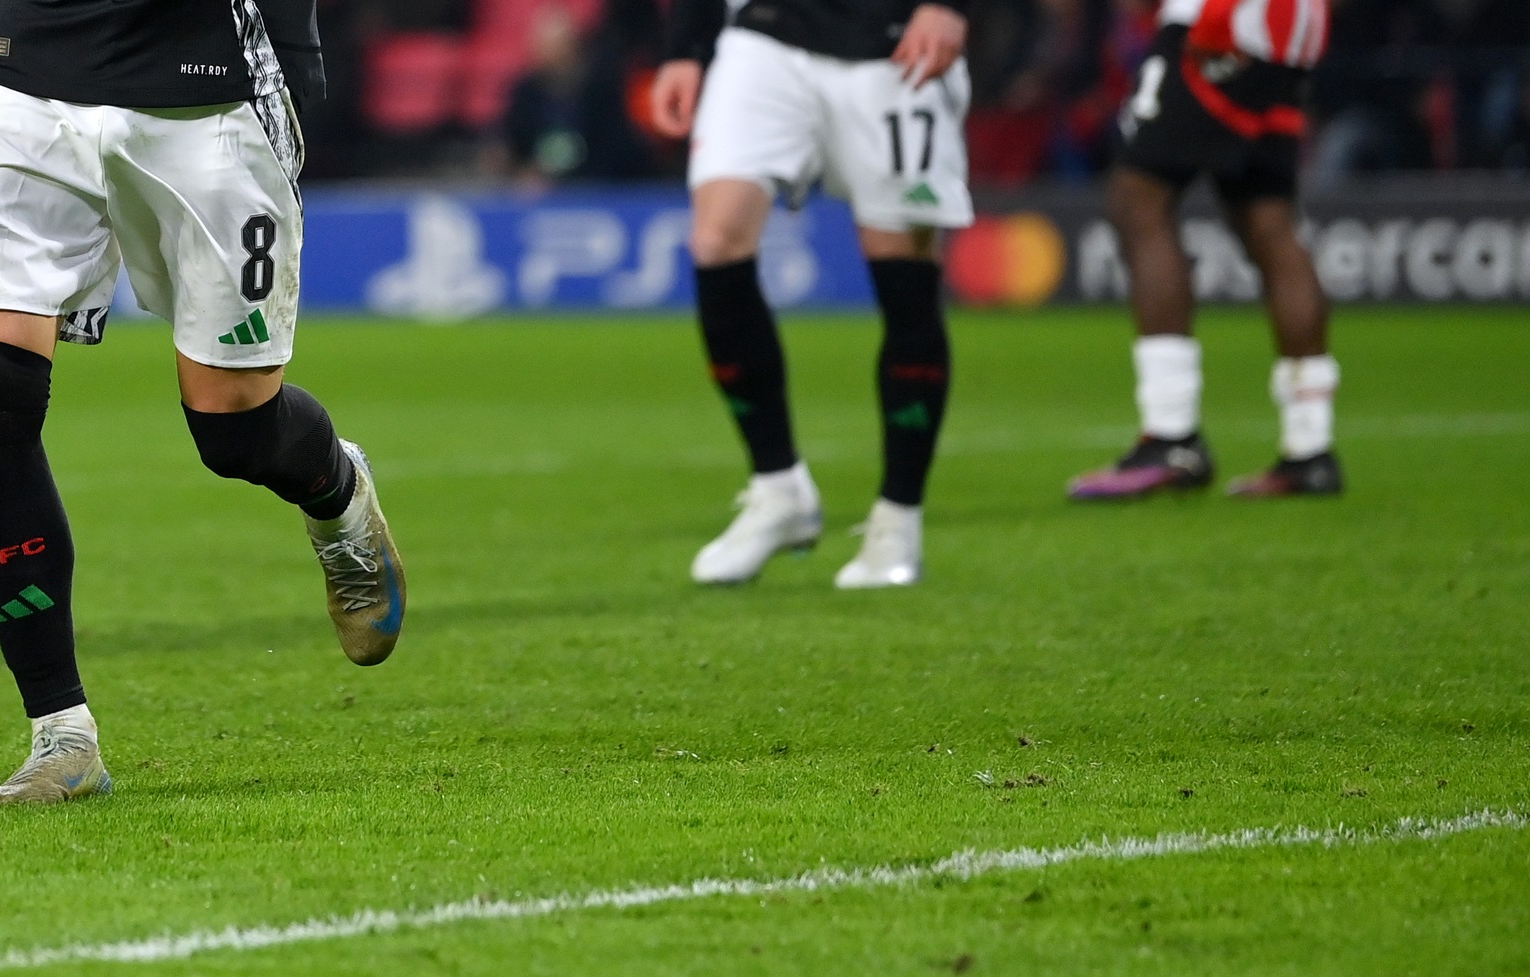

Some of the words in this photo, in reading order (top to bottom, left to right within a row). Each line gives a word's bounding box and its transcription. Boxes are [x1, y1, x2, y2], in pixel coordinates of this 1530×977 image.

[180, 63, 228, 77] HEAT.RDY
[885, 109, 935, 175] 17
[240, 213, 277, 303] 8
